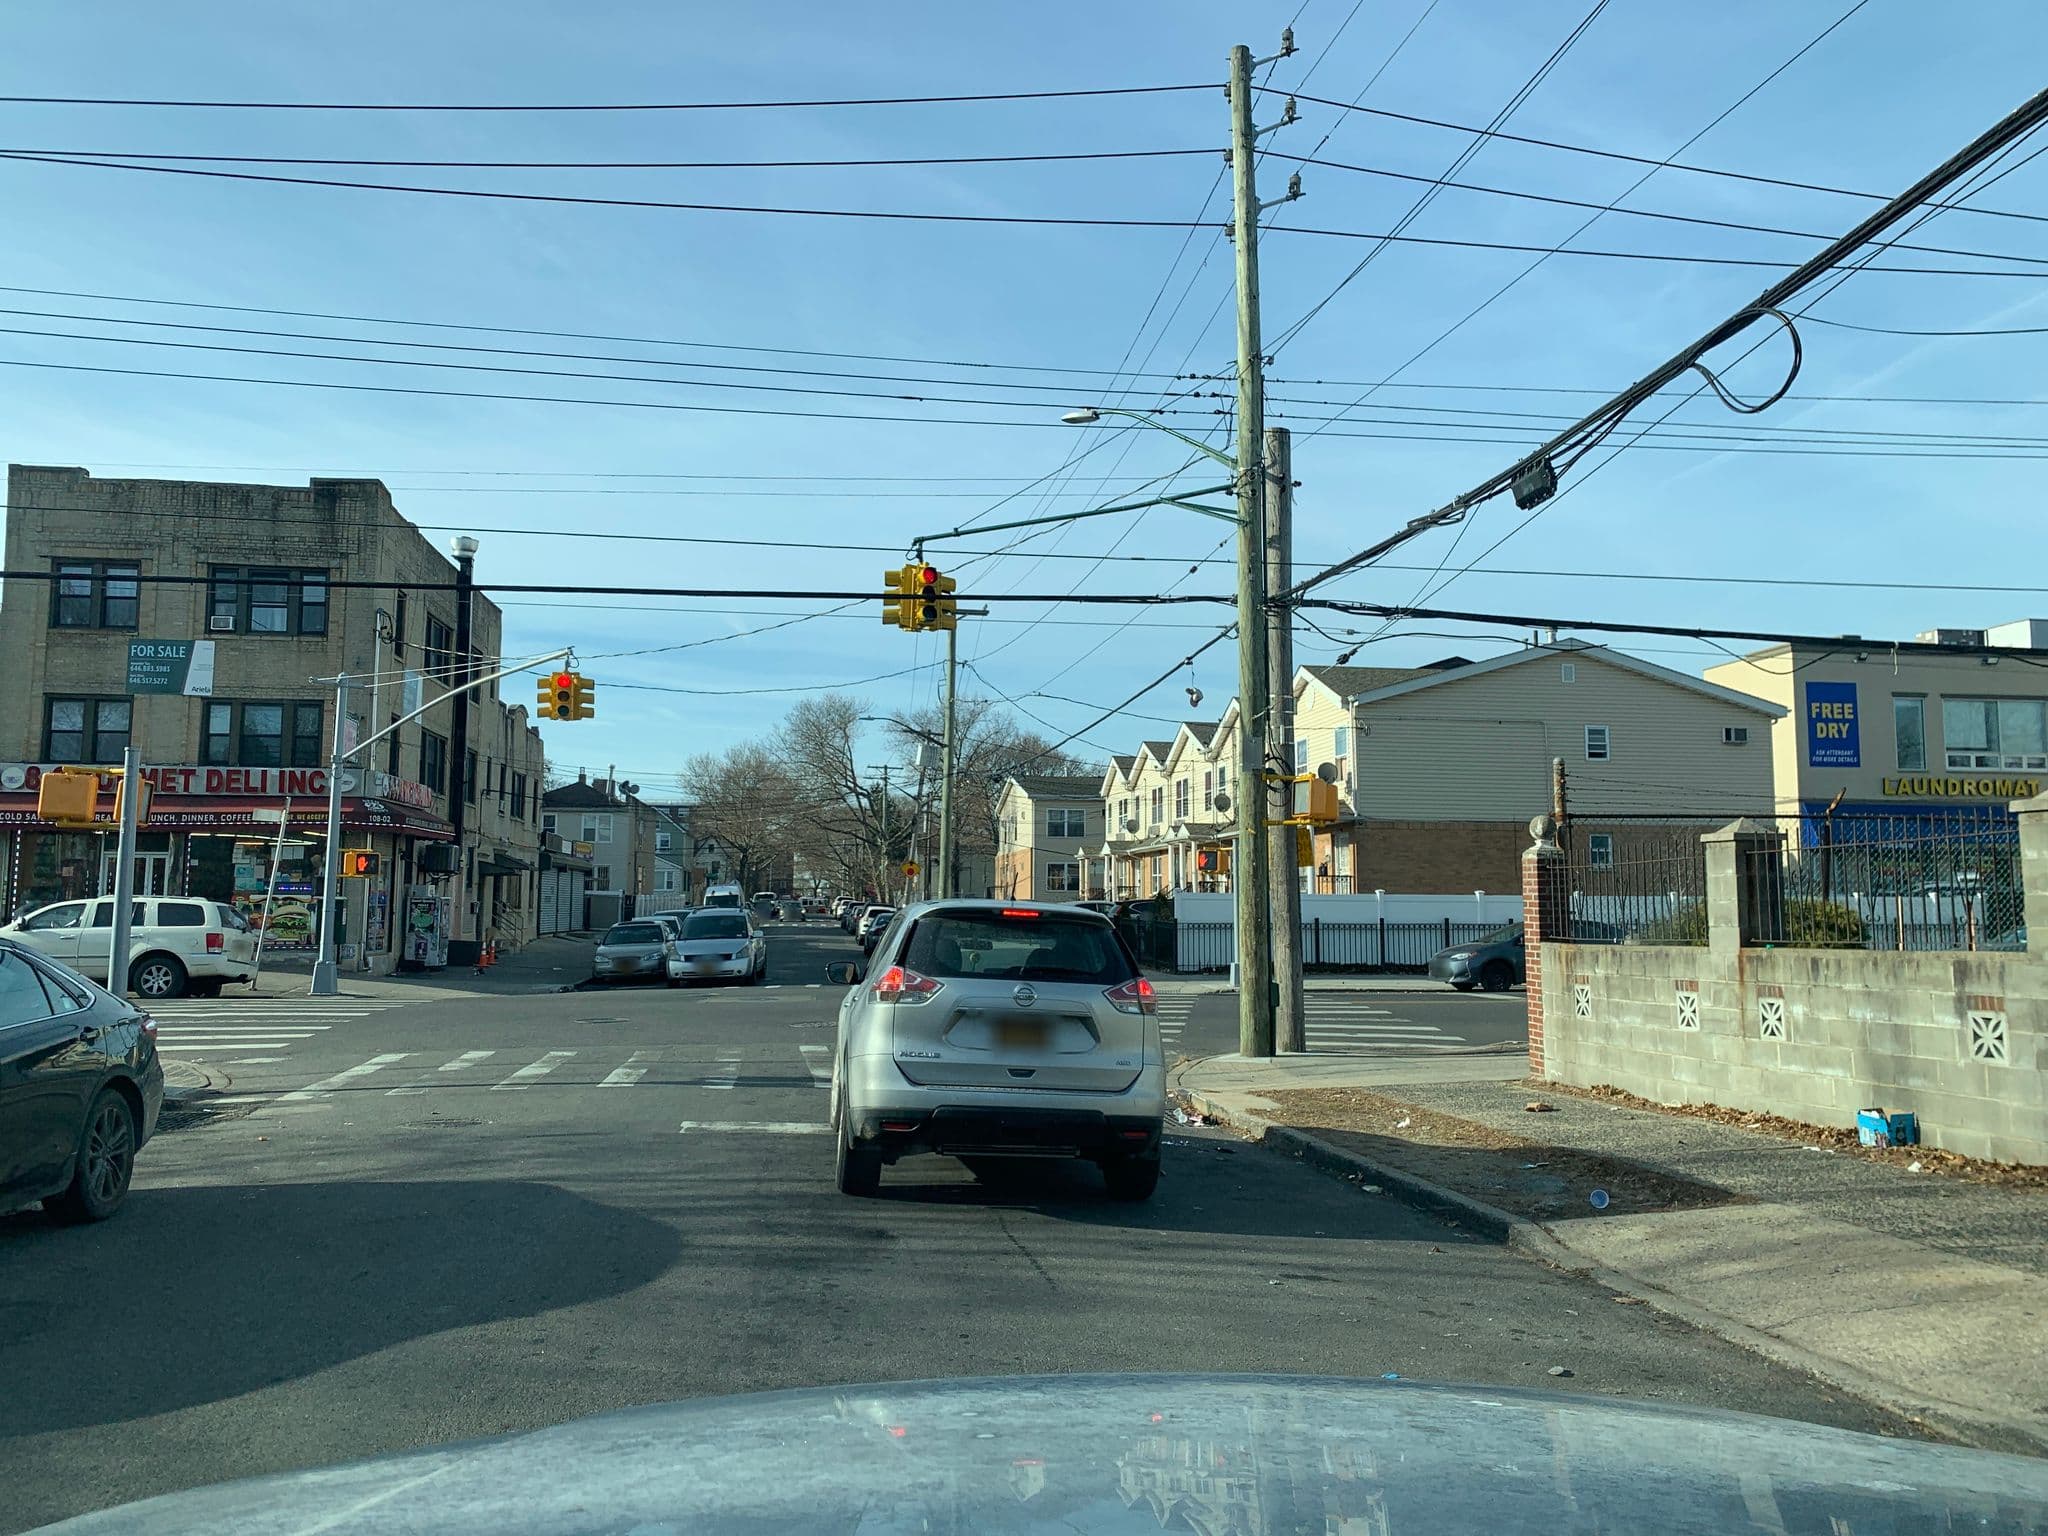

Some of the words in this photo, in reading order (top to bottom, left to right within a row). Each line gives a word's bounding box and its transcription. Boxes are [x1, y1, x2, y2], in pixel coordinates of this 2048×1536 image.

[131, 645, 154, 657] FOR
[157, 645, 186, 658] SALE
[1811, 702, 1854, 719] FREE
[1816, 722, 1850, 739] DRY
[205, 768, 268, 793] DELI
[278, 769, 326, 793] INC
[1883, 777, 2040, 797] LAUNDROMAT
[0, 813, 22, 821] COLD
[150, 814, 178, 822] UNCH,
[220, 814, 252, 822] COFFEE
[369, 815, 391, 823] 108-02
